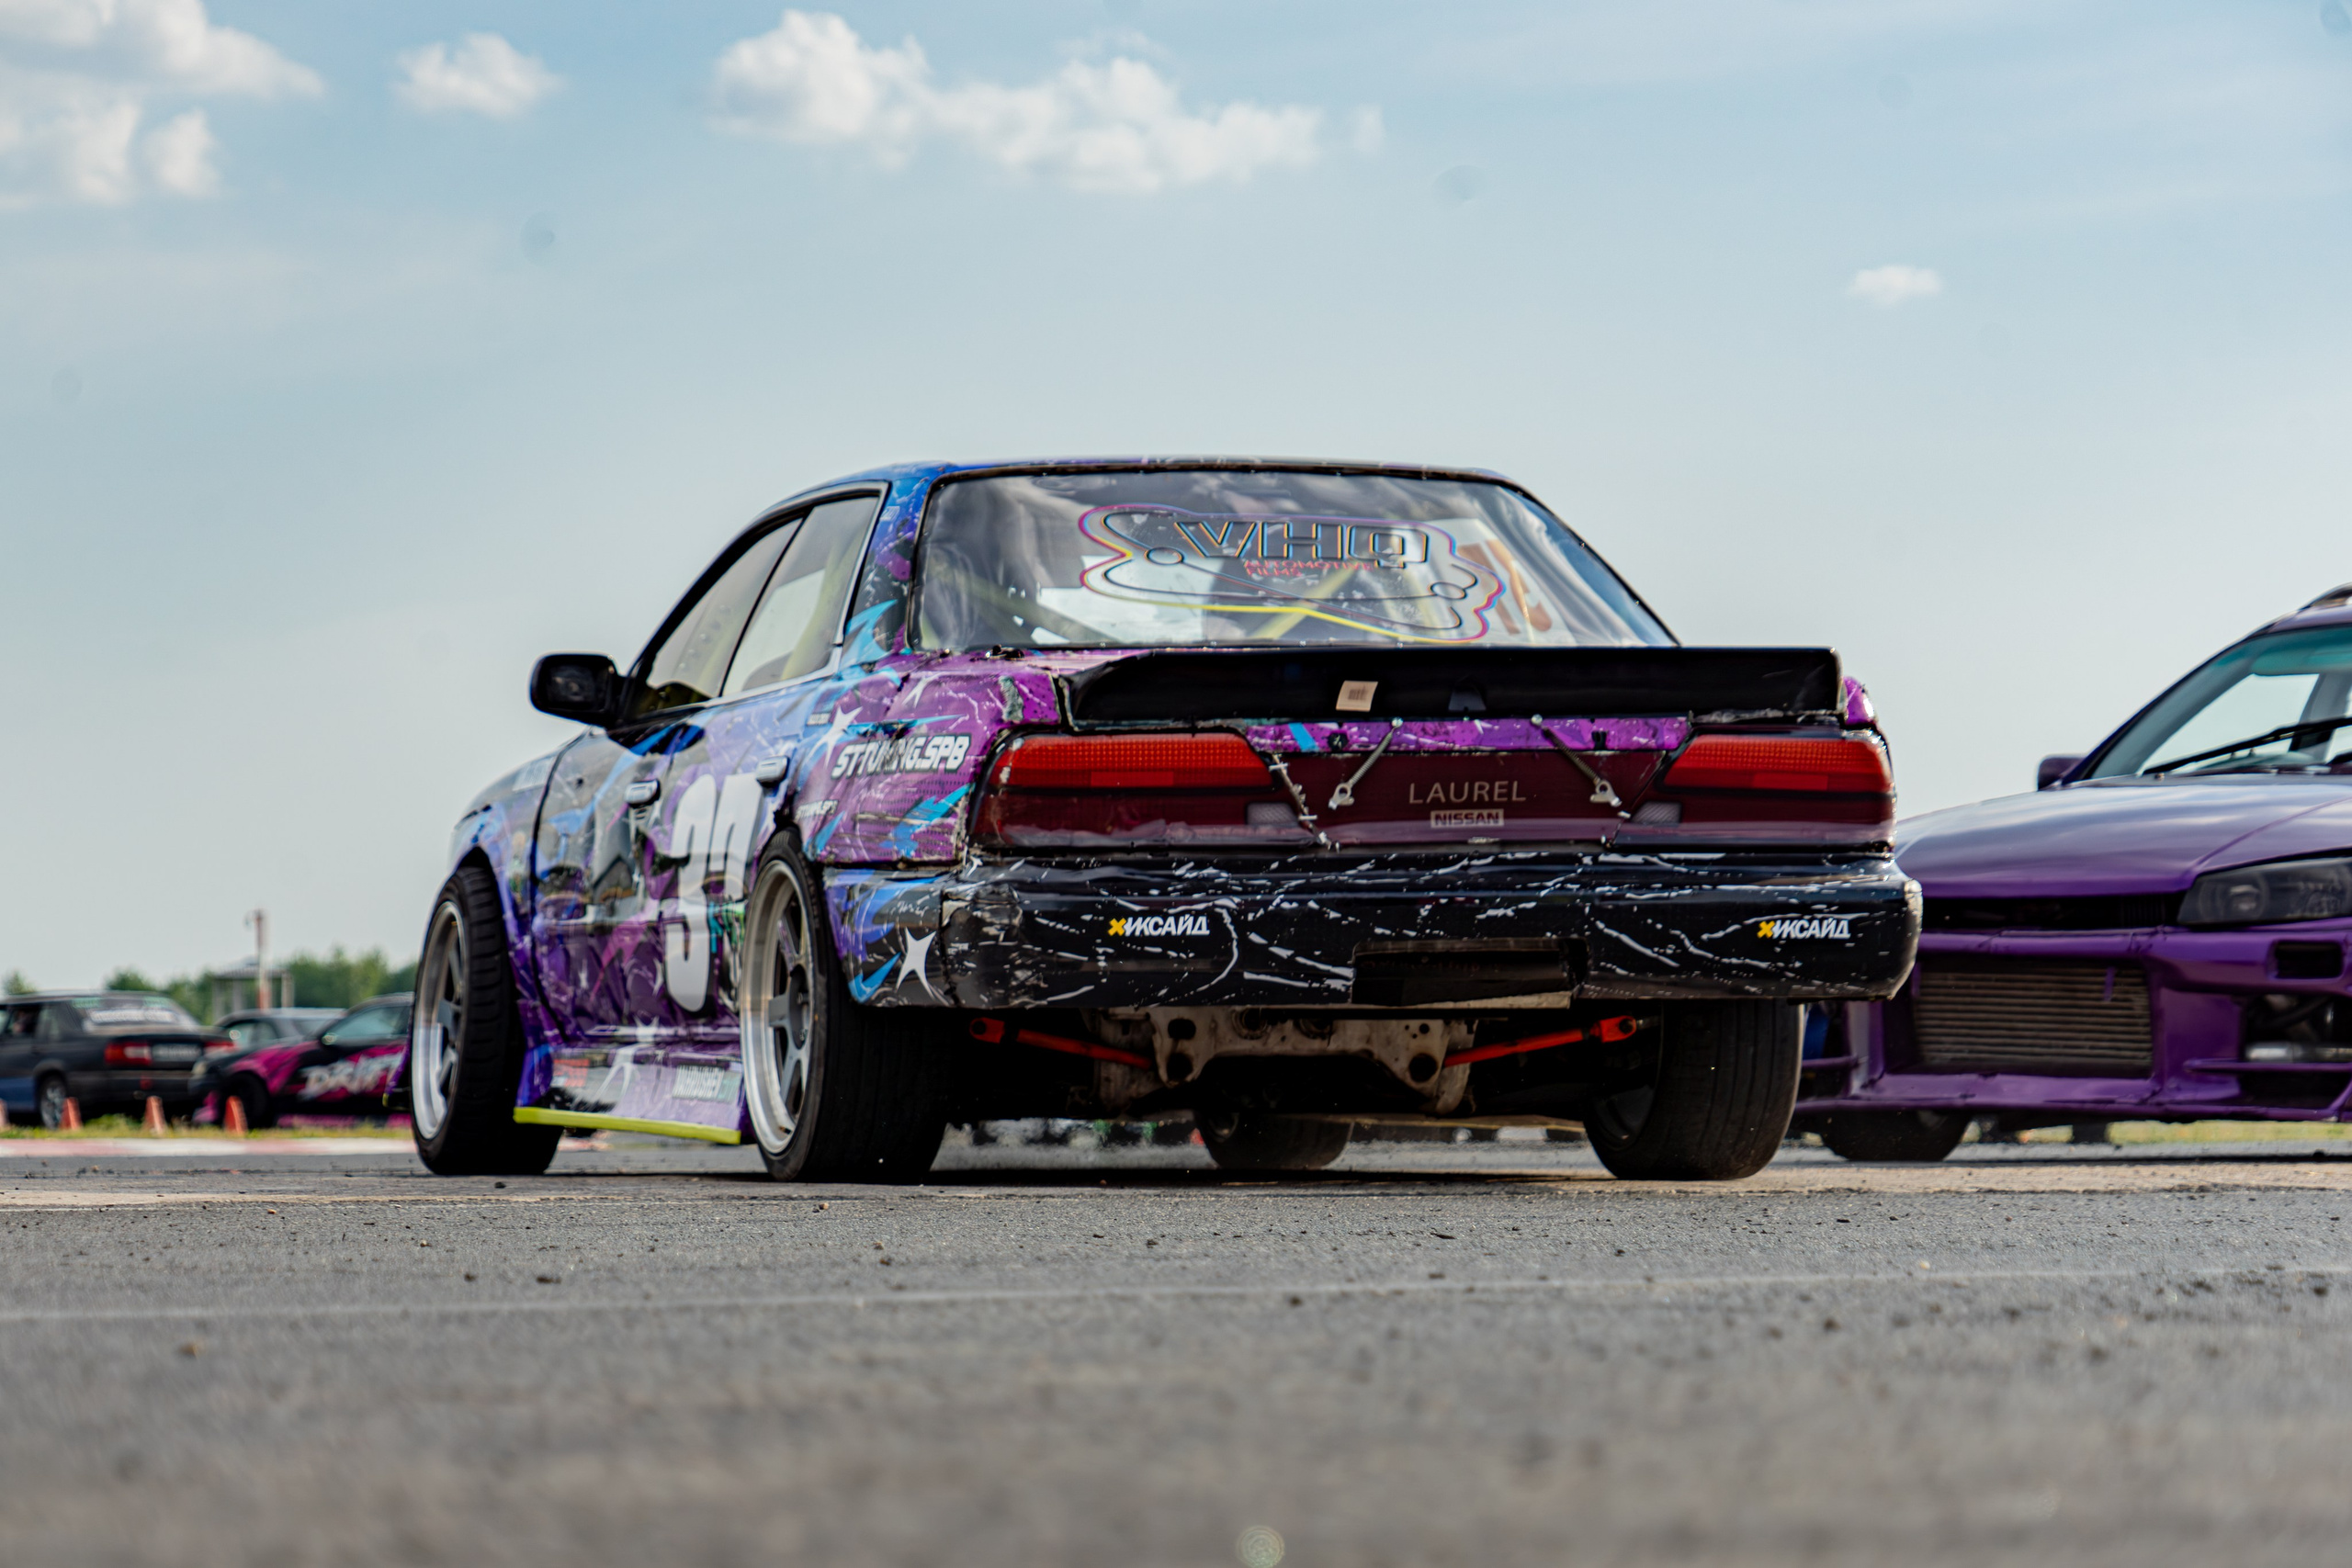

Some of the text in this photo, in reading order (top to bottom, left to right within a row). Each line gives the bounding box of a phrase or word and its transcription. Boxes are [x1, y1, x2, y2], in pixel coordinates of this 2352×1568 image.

[1173, 520, 1430, 570] VHQ
[1243, 558, 1374, 571] AUTOMOTIVE
[1245, 567, 1304, 578] FILMS
[1408, 780, 1527, 805] LAUREL
[1433, 810, 1501, 827] NISSAN
